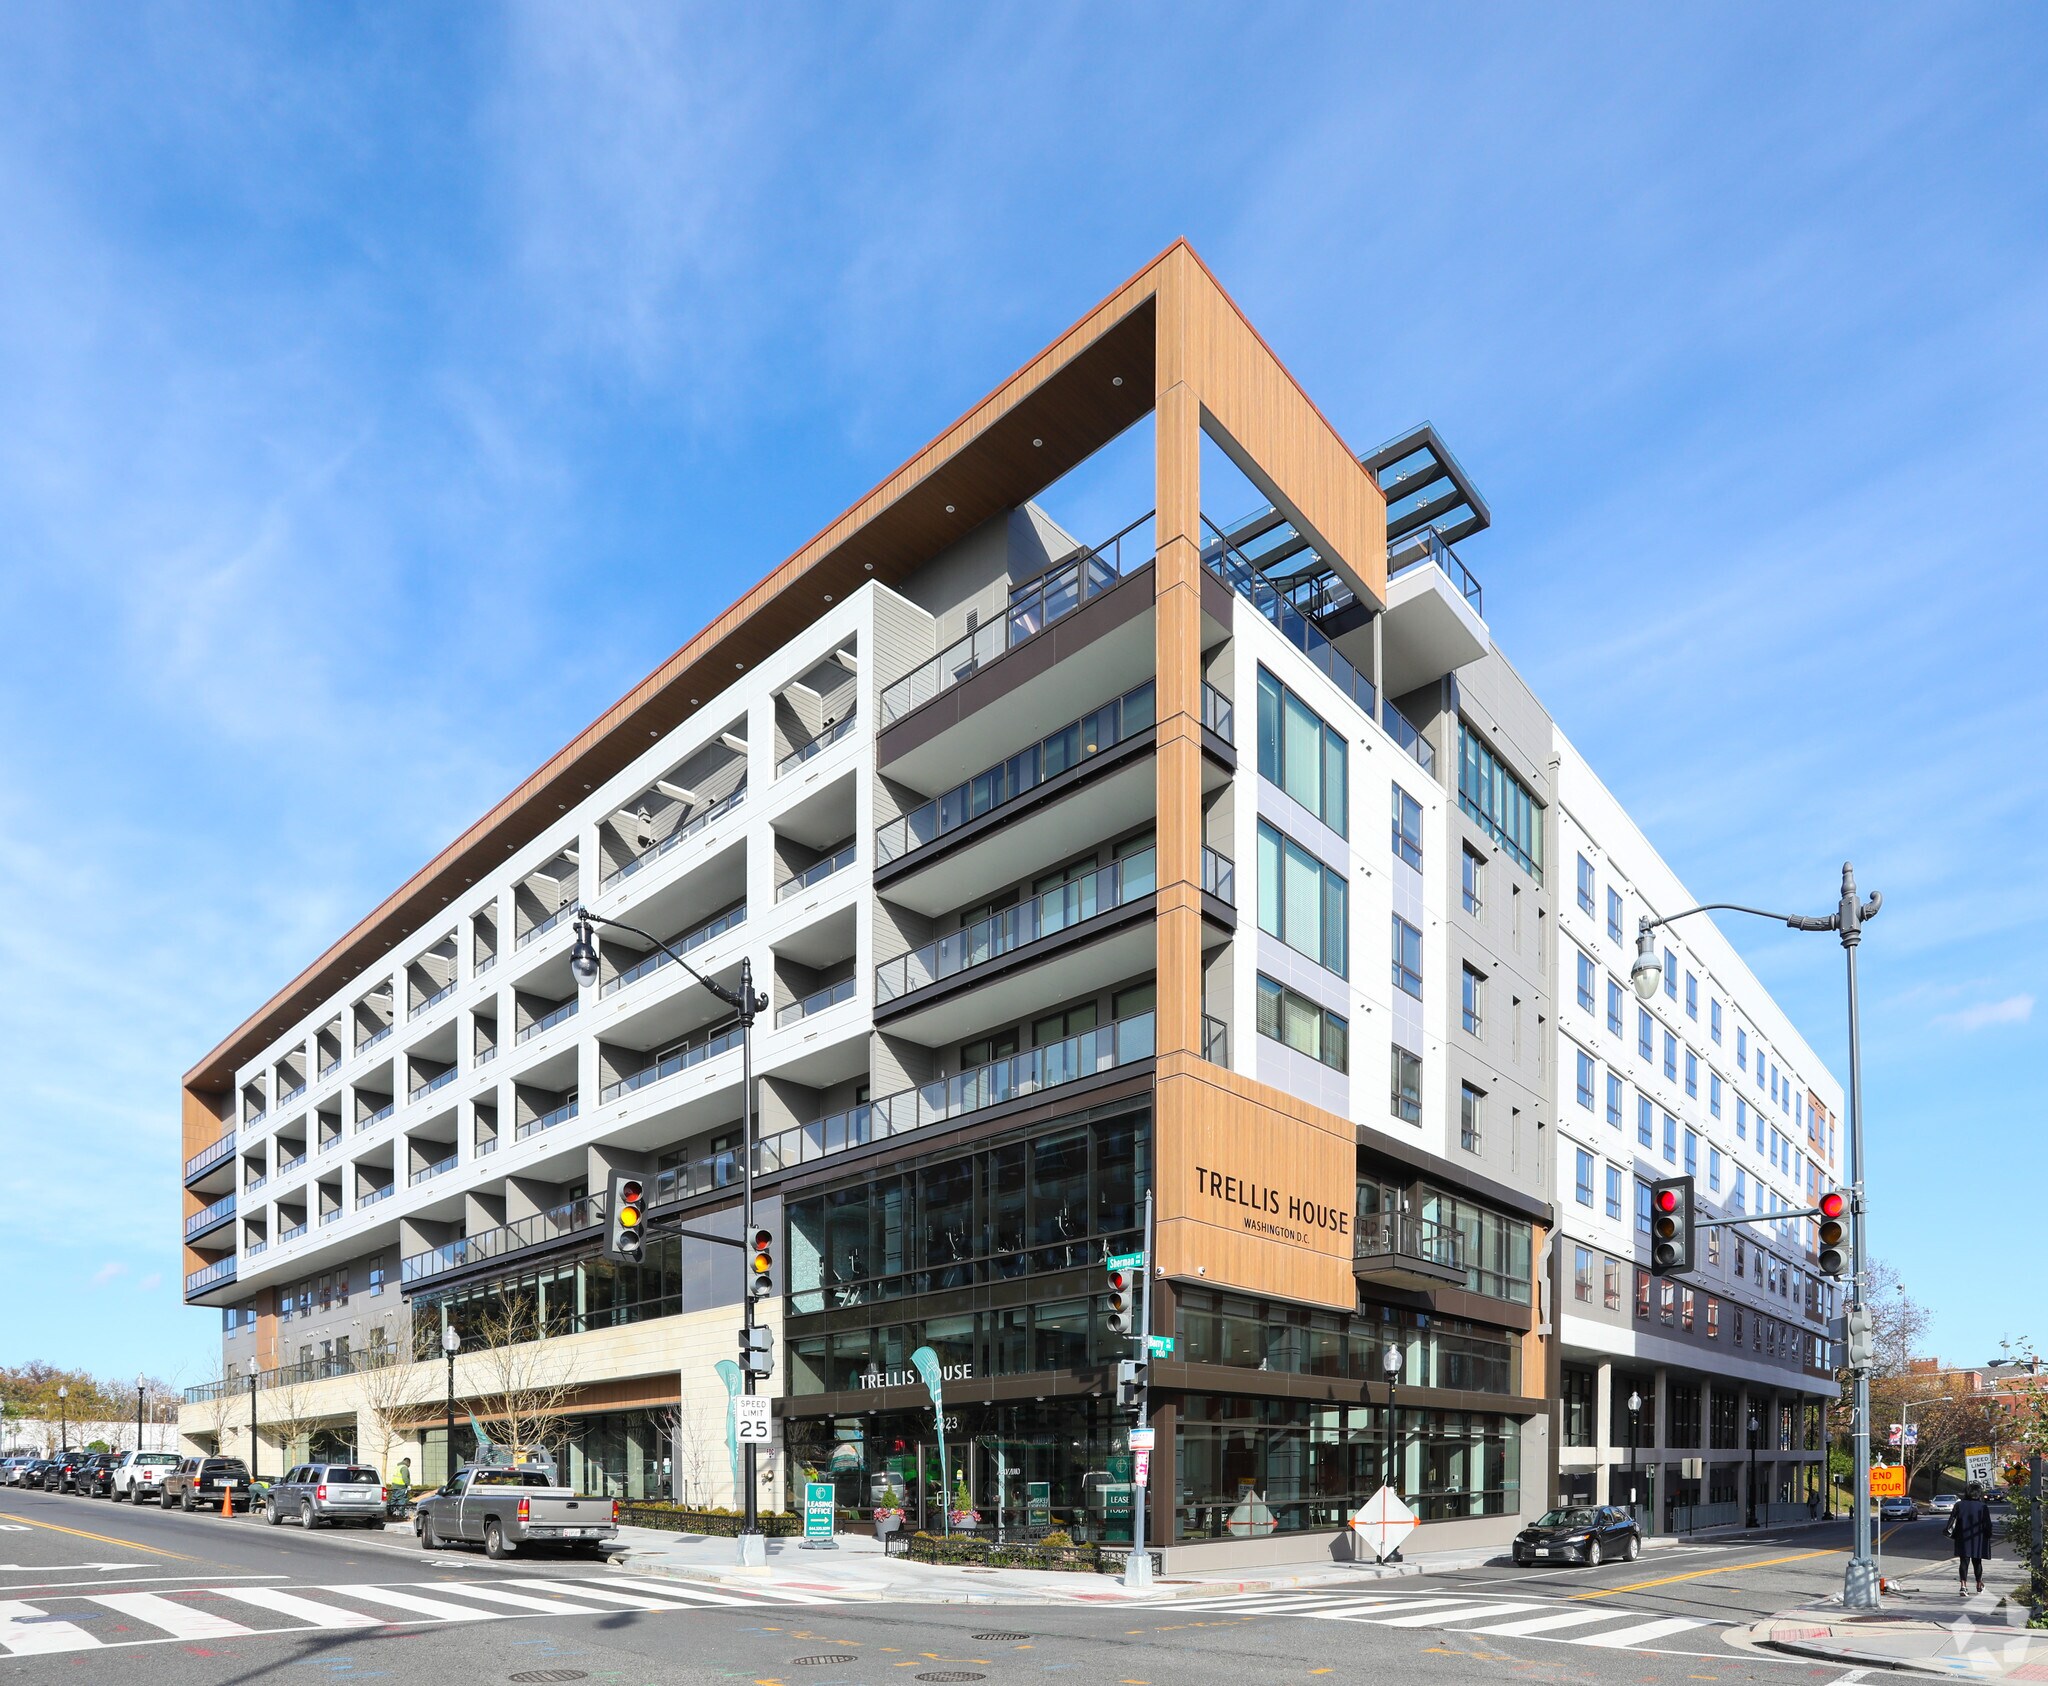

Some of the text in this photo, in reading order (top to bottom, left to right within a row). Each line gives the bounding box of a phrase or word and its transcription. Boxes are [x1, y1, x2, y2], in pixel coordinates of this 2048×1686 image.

[1196, 1166, 1348, 1235] TRELLIS HOUSE
[1243, 1217, 1310, 1245] WASHINGTON D.C.
[1109, 1257, 1135, 1269] Sherman
[1148, 1336, 1164, 1351] Barry
[1155, 1349, 1166, 1358] 900
[859, 1363, 973, 1390] TRELLIS USE
[740, 1400, 767, 1408] SPEED
[742, 1409, 764, 1417] LIMIT
[740, 1420, 768, 1438] 25
[1968, 1456, 1989, 1464] SPEED
[1872, 1472, 1892, 1480] END
[1972, 1468, 1988, 1479] 15
[1869, 1483, 1902, 1492] ETOUR
[807, 1500, 833, 1508] LEASING
[1110, 1496, 1130, 1504] LEASE
[808, 1507, 832, 1515] OFFICE
